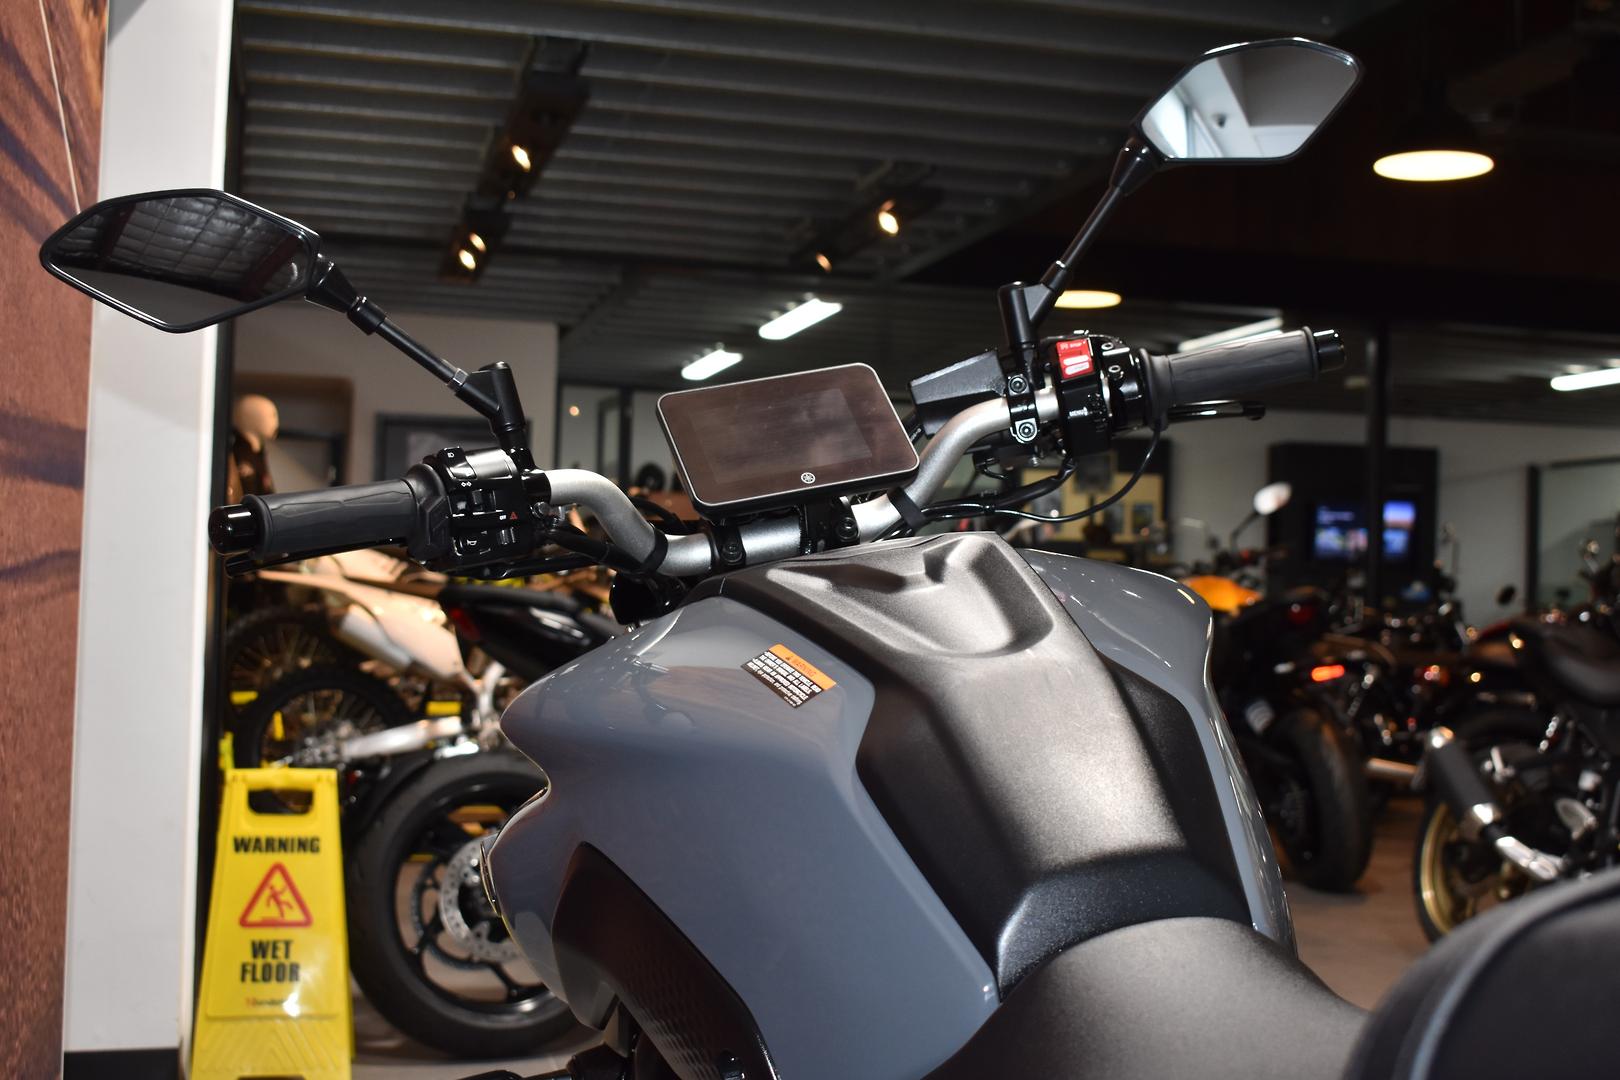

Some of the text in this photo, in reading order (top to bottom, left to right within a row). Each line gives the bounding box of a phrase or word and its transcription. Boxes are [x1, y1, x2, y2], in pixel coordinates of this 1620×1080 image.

[233, 836, 320, 853] WARNING
[251, 939, 294, 959] WET
[240, 962, 300, 983] FLOOR
